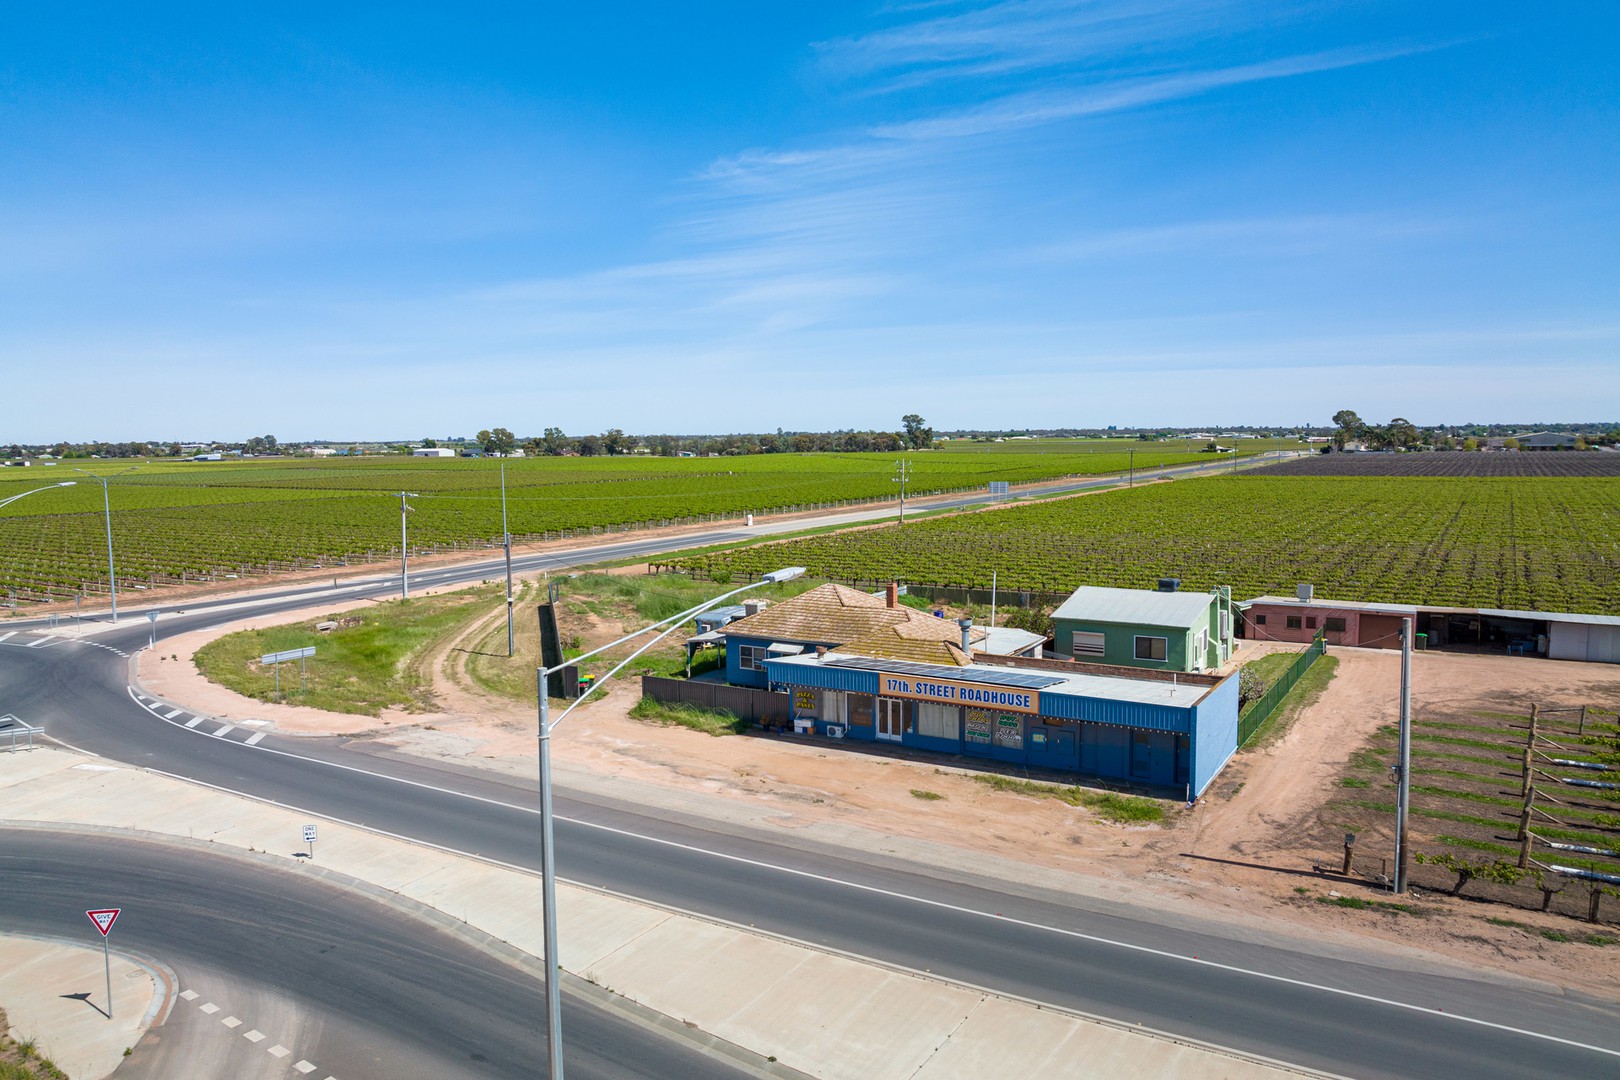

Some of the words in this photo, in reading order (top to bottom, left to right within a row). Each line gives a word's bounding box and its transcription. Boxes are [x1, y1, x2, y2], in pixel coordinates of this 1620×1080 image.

[887, 679, 913, 693] 17th.
[915, 682, 956, 699] STREET
[959, 687, 1031, 708] ROADHOUSE
